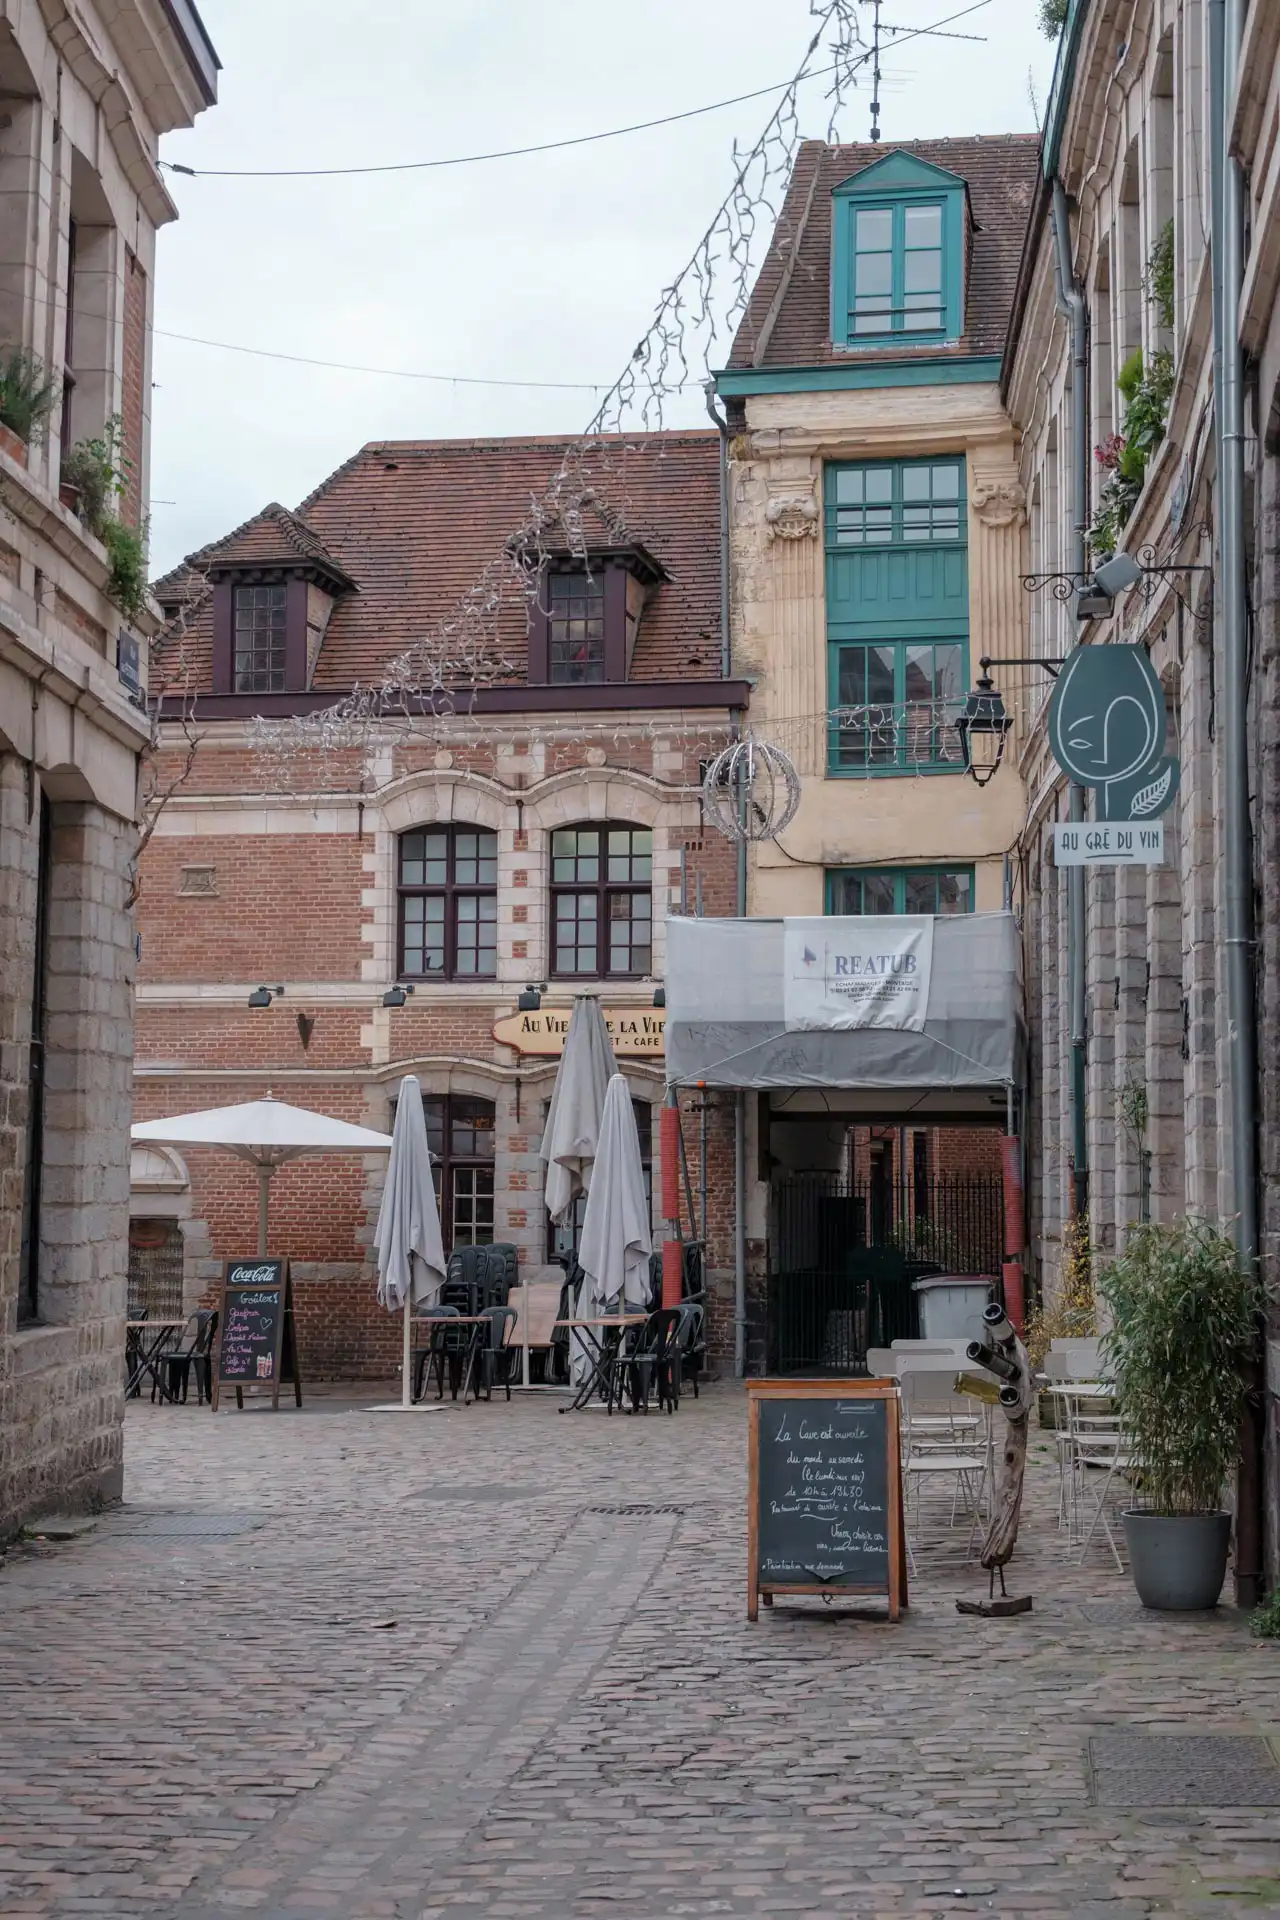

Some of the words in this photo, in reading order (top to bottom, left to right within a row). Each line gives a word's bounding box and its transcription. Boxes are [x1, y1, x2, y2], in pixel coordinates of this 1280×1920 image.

[1061, 833, 1079, 850] AU
[1118, 831, 1132, 849] DU
[1140, 831, 1159, 848] VIN
[834, 954, 917, 976] REATUB
[545, 1016, 569, 1033] VIE
[620, 1021, 637, 1033] LA
[634, 1037, 659, 1046] CAFE
[231, 1265, 277, 1283] Coca-Cola
[775, 1412, 792, 1442] La
[799, 1419, 819, 1440] Cave
[820, 1423, 833, 1440] est
[834, 1422, 868, 1439] ouverte
[787, 1450, 800, 1463] du
[838, 1452, 864, 1464] samedi
[815, 1468, 835, 1480] lundi
[785, 1484, 796, 1497] de
